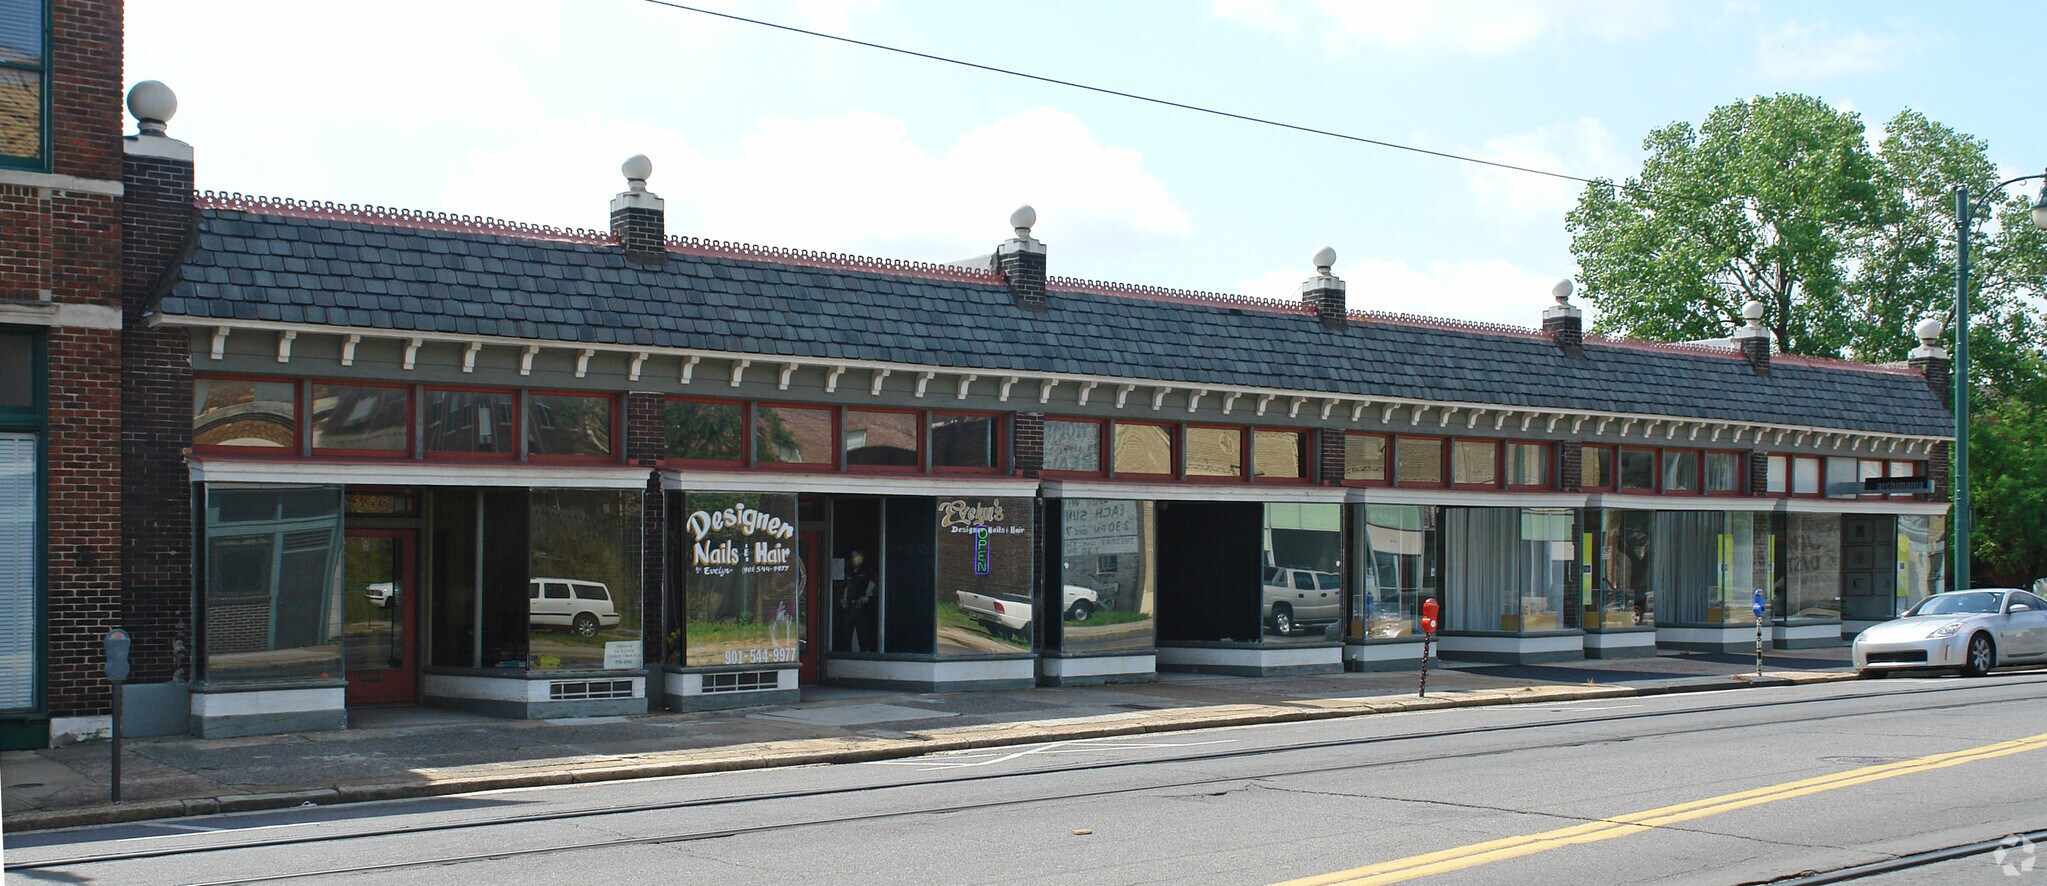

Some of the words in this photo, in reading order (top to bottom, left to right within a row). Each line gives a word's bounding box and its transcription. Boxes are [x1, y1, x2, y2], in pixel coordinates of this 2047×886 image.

[1877, 480, 1924, 490] archimania
[686, 502, 795, 542] Designer
[938, 498, 1005, 528] Evelyn's
[693, 539, 740, 566] Nails
[754, 541, 791, 566] Hair
[977, 528, 989, 572] OPEN
[724, 648, 797, 665] 901-544-9977
